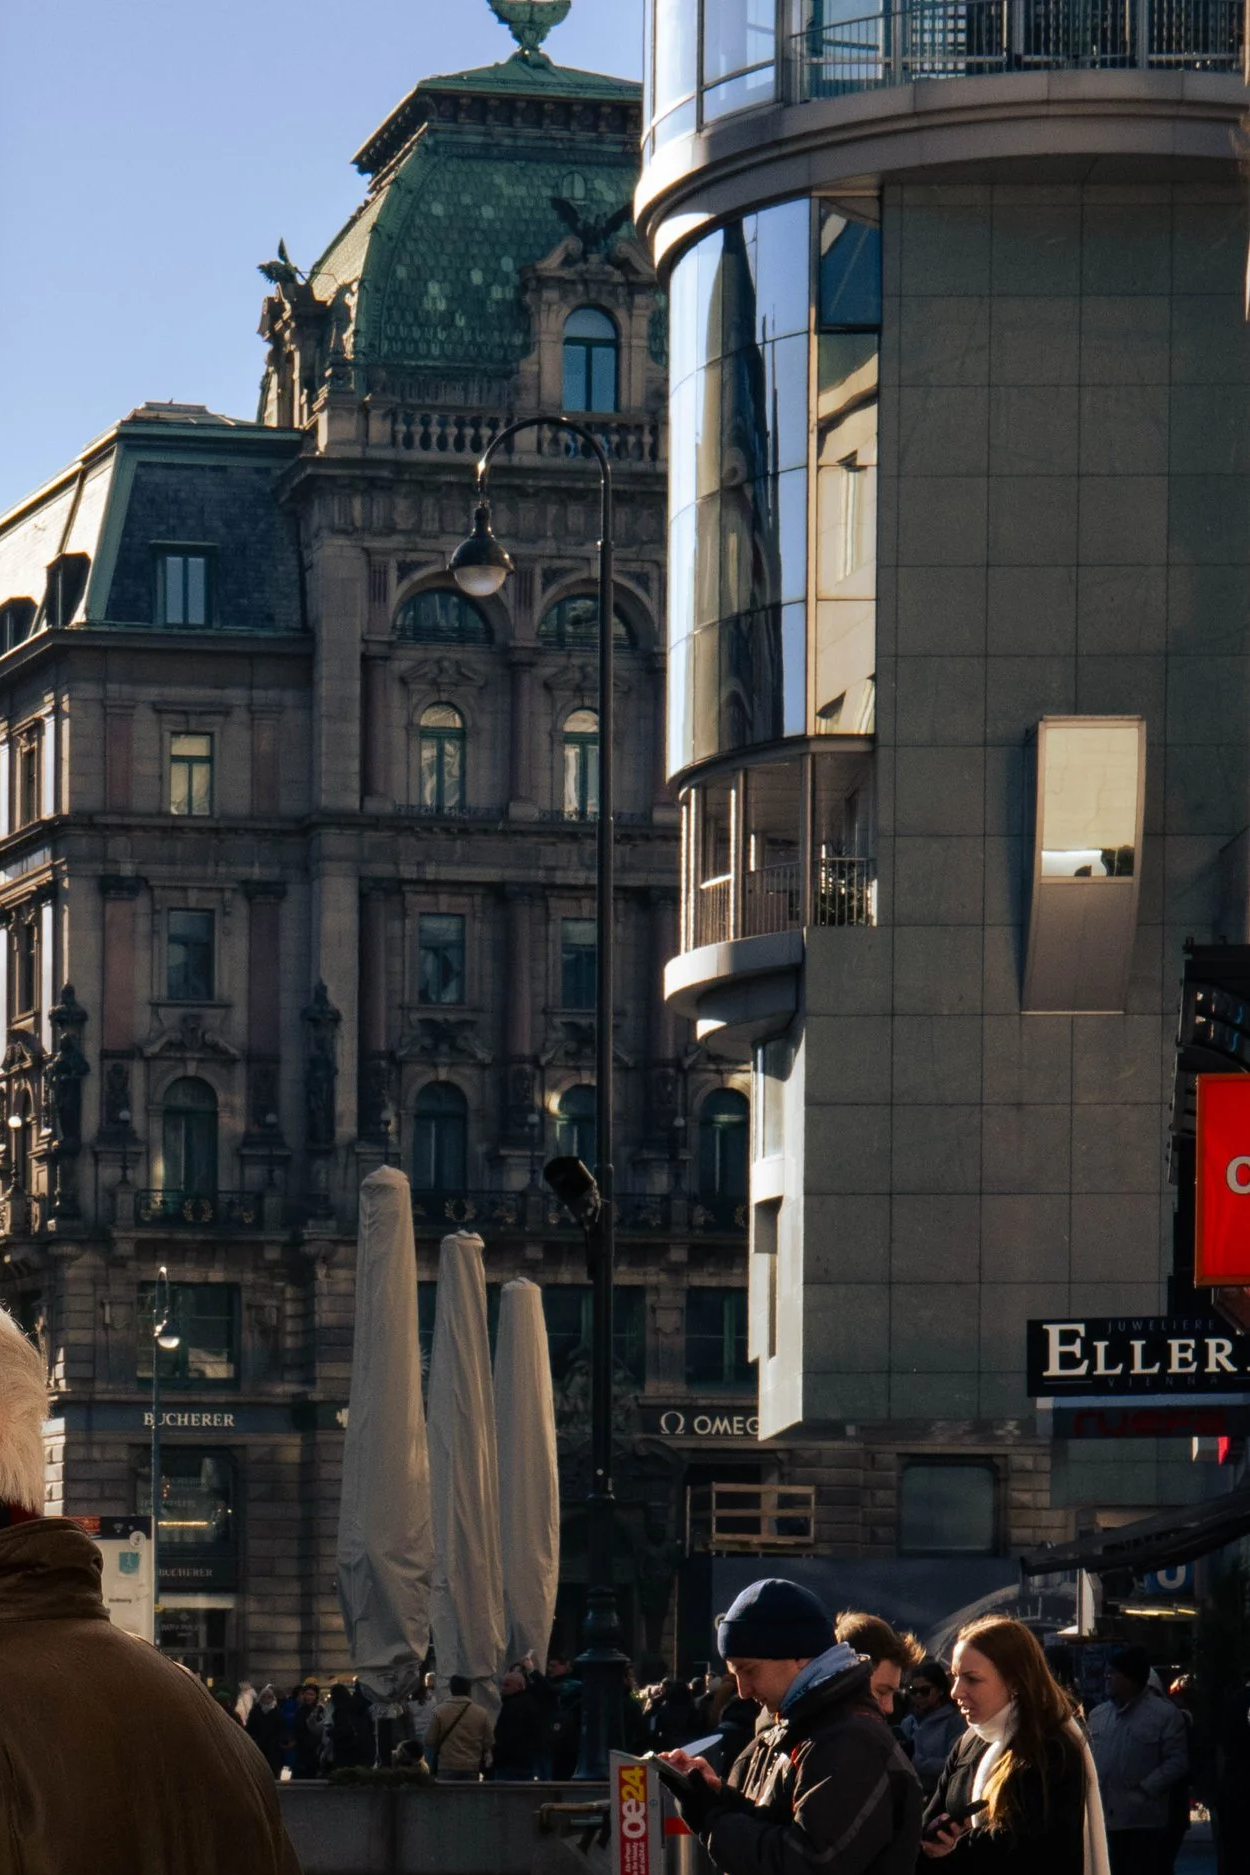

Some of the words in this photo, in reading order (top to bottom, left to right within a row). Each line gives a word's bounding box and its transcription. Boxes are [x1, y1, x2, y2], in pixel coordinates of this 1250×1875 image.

[1107, 1320, 1215, 1334] JUWELIERE
[1042, 1323, 1250, 1376] ELLER
[1108, 1376, 1218, 1388] VIENNA
[622, 1766, 646, 1838] oe24
